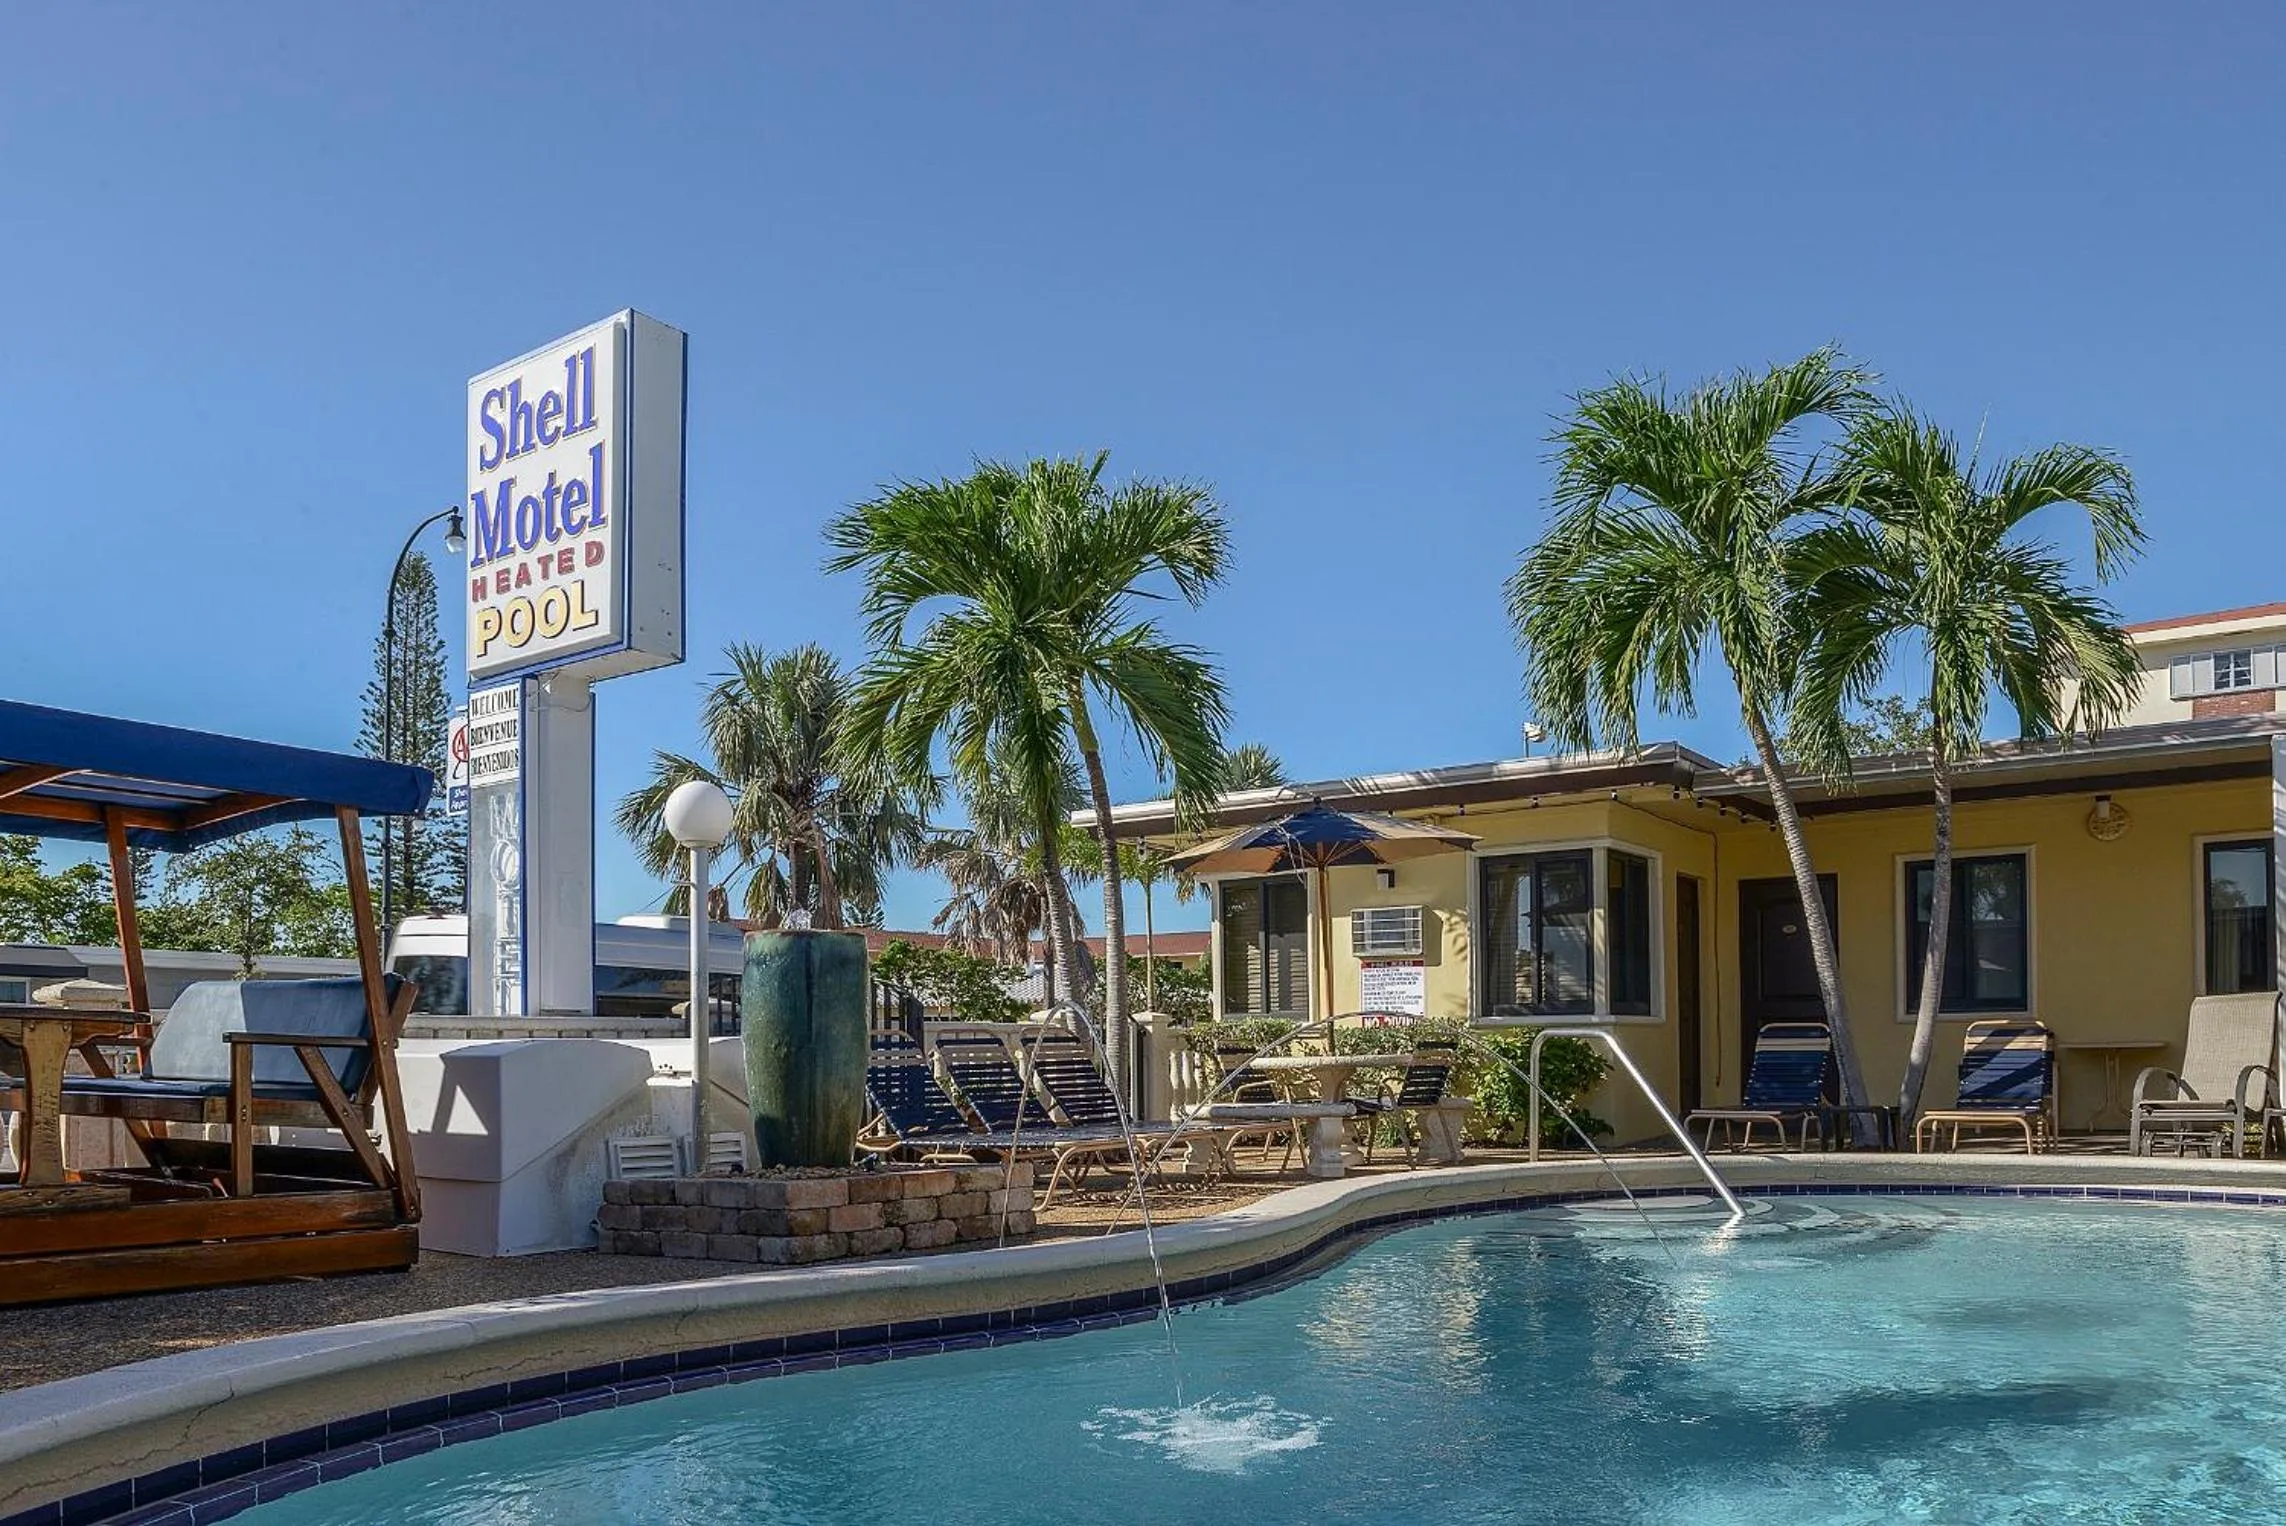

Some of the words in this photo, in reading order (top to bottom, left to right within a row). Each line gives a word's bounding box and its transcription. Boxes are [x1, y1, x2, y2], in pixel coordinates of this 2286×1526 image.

[480, 343, 597, 473] Shell
[470, 439, 608, 568] Motel
[472, 540, 606, 602] HEATED
[475, 580, 599, 658] POOL
[471, 687, 519, 717] WELCOME
[471, 719, 518, 747] BIENVENUE
[471, 748, 519, 776] BIENVENIDOS
